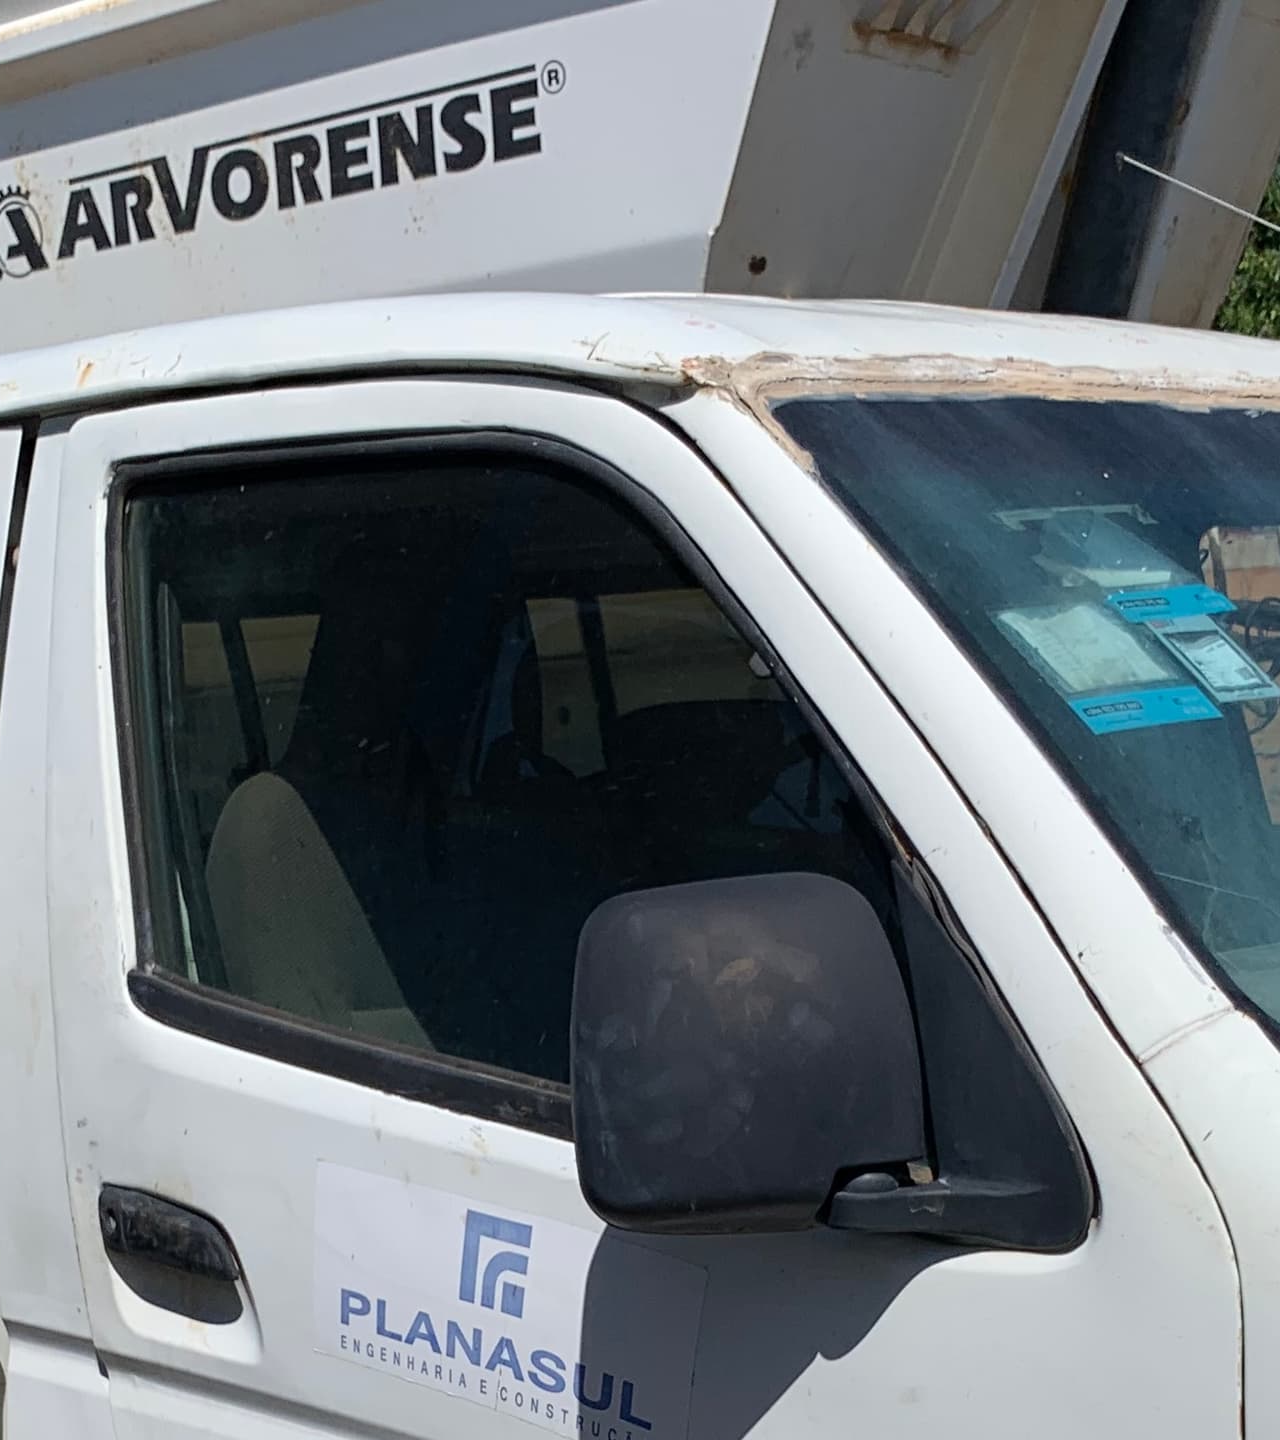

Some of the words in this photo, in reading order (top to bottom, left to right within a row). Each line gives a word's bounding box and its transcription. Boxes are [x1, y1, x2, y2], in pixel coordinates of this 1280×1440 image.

[57, 68, 542, 261] ARVORENSE
[340, 1287, 653, 1432] PLANASUL
[340, 1334, 468, 1389] ENGENHARIA
[479, 1380, 489, 1395] E
